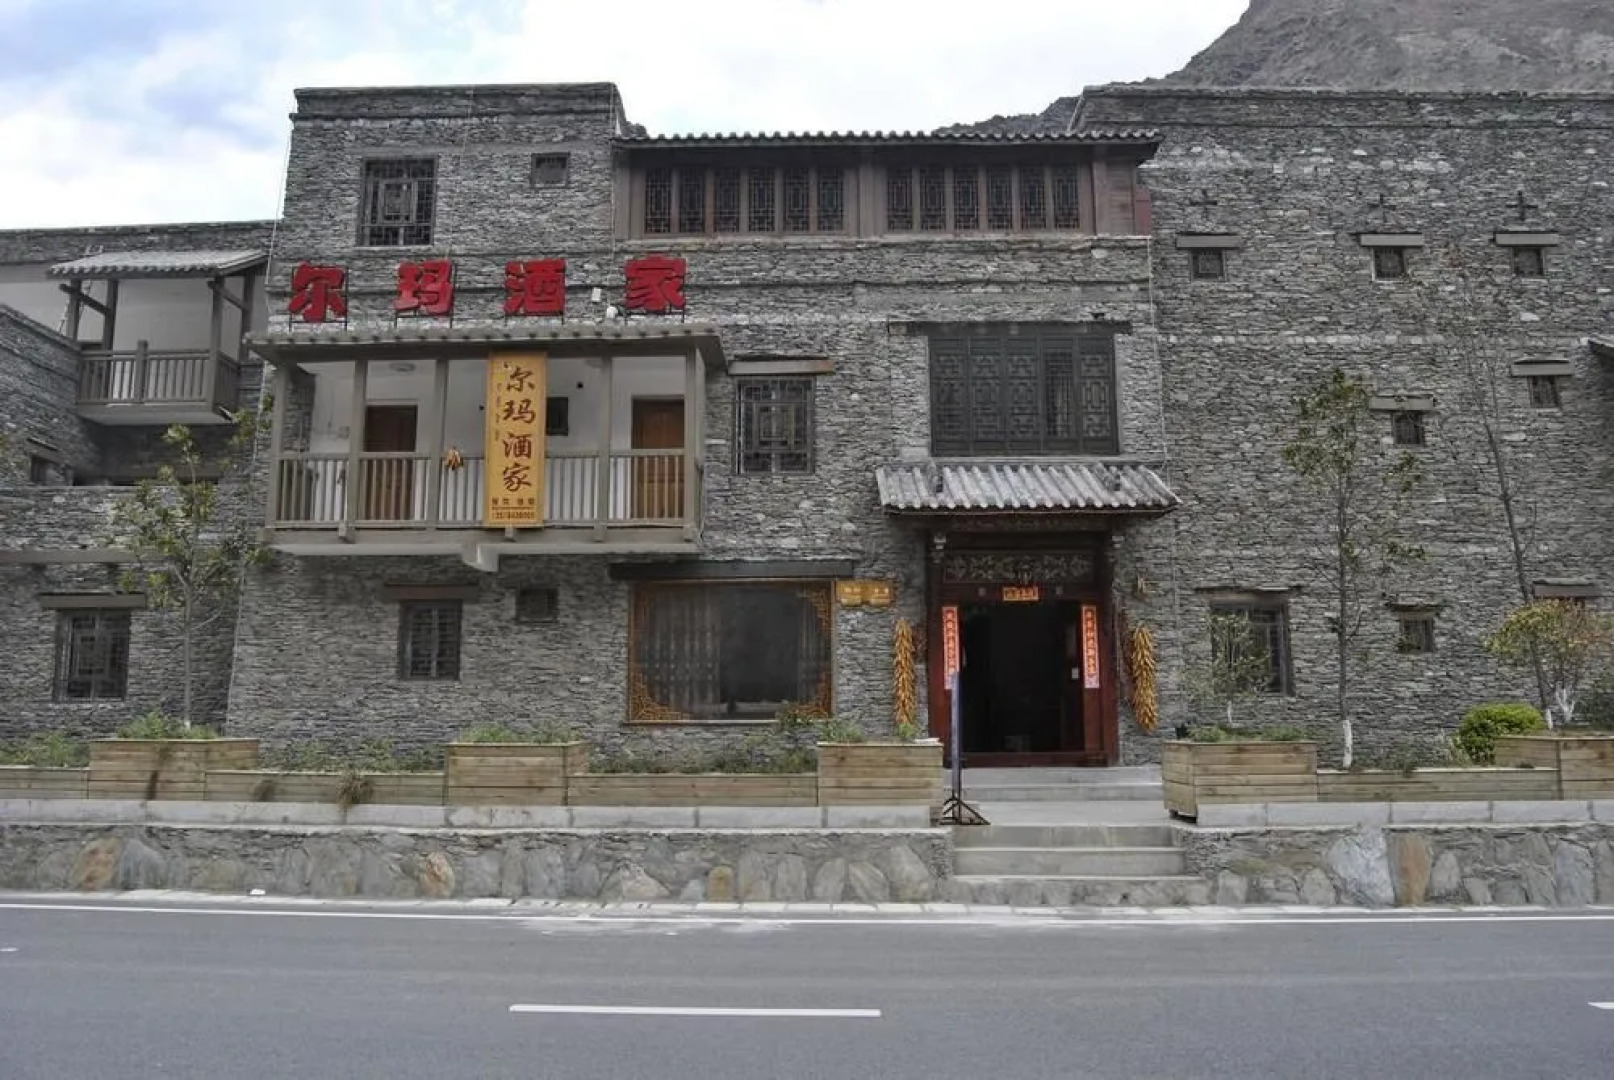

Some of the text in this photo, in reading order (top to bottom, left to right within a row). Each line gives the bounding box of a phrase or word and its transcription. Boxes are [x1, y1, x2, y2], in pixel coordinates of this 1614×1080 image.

[288, 254, 686, 323] 尔玛酒家
[502, 365, 537, 492] 尔玛酒家
